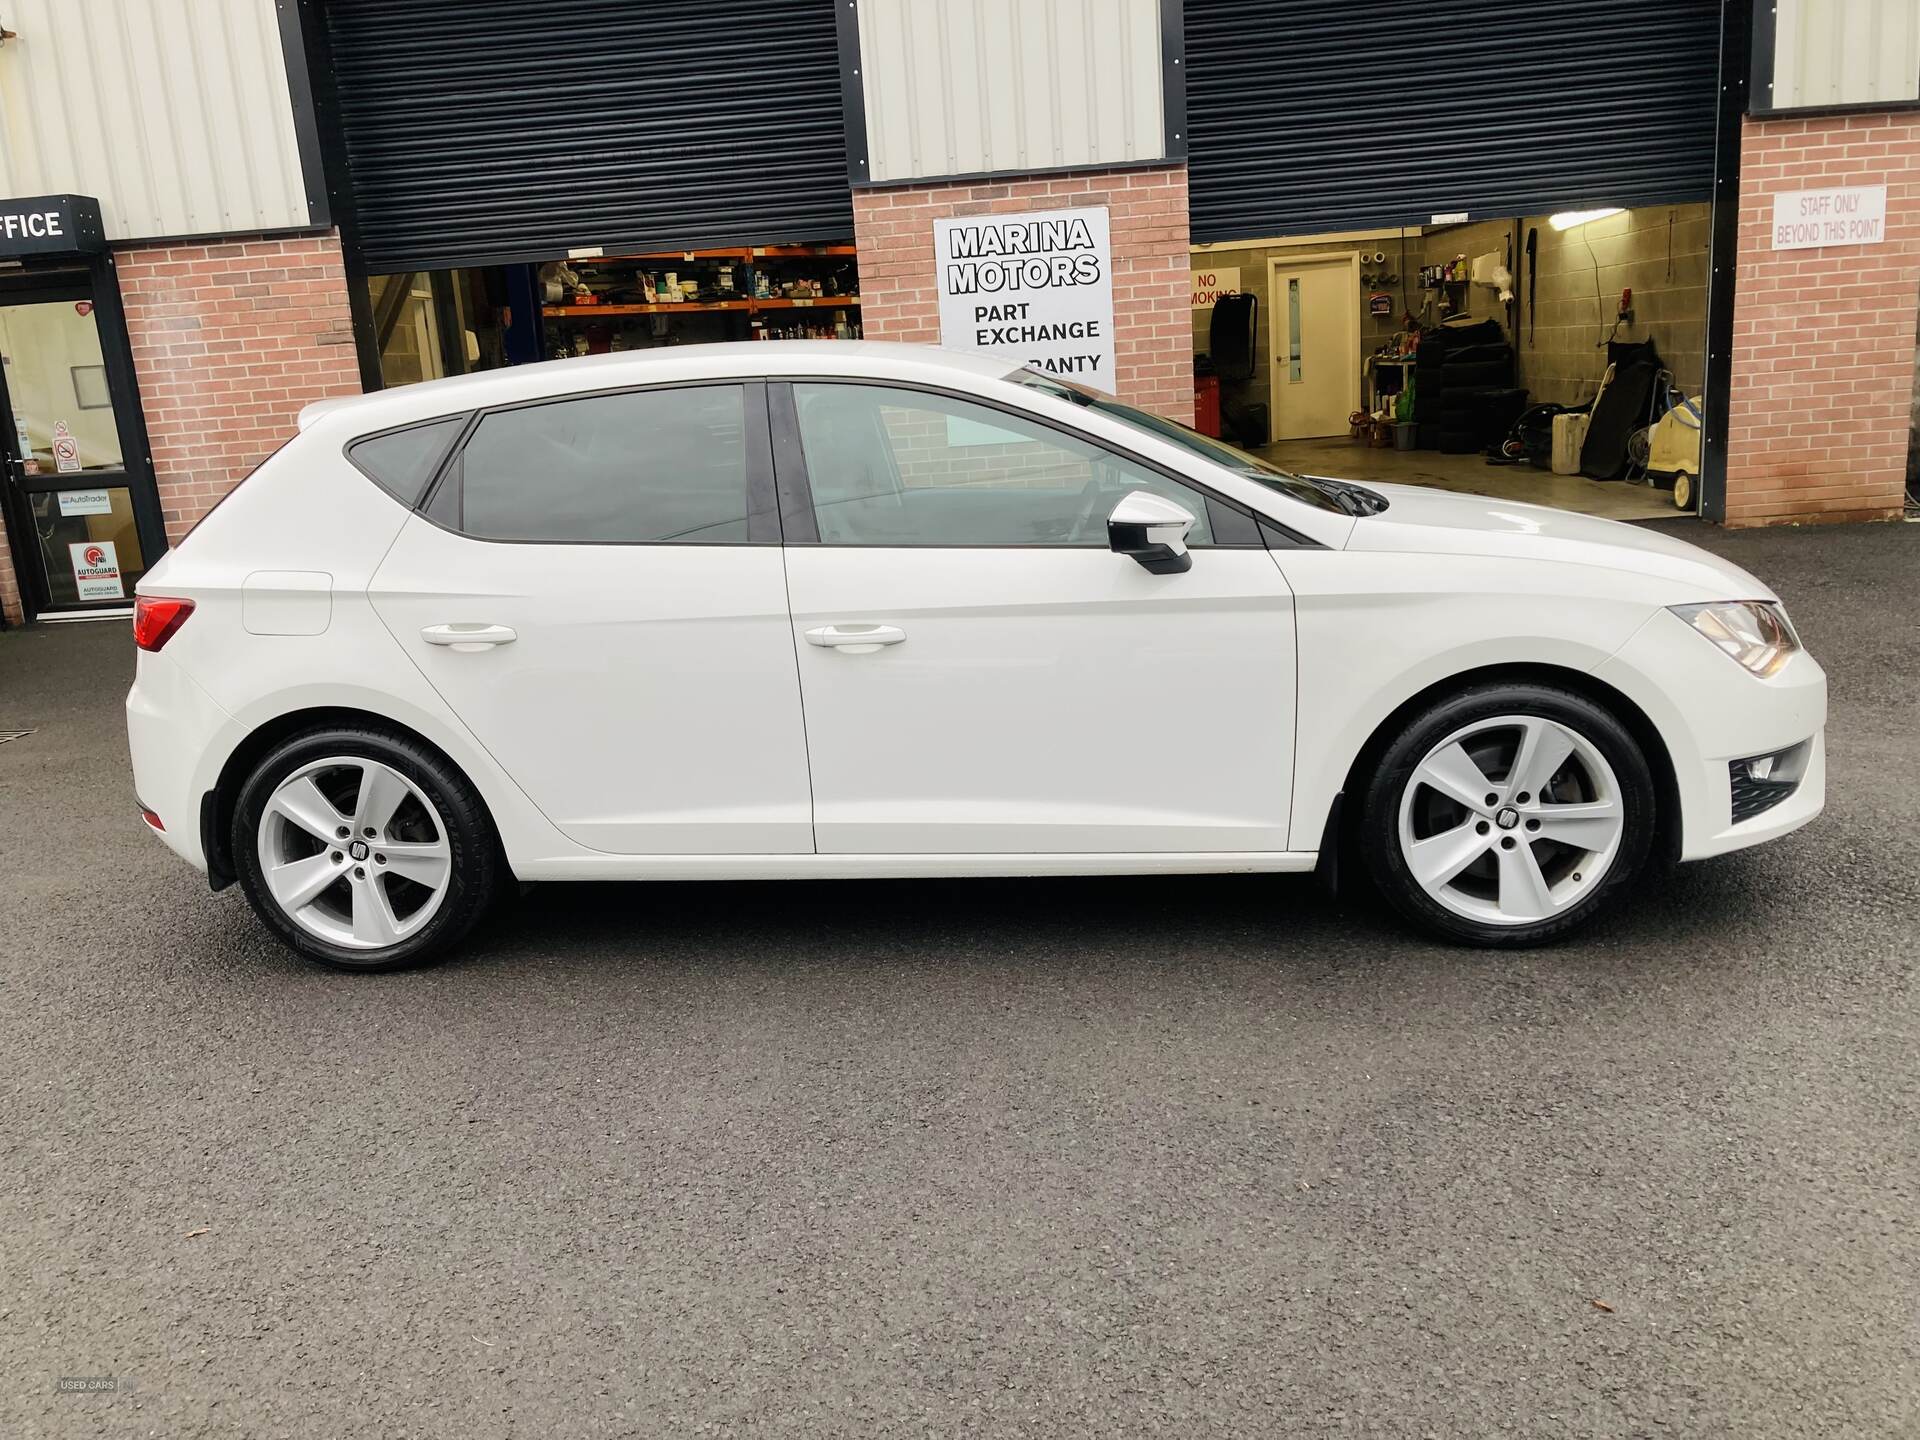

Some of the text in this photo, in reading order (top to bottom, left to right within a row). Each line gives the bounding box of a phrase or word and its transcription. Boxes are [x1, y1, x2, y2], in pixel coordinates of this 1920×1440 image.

[1800, 194, 1860, 216] STAFF ONLY
[0, 212, 63, 239] FICE
[950, 218, 1094, 258] MARINA
[1777, 218, 1880, 244] BEYOND THIS POINT
[948, 254, 1100, 294] MOTORS
[1198, 273, 1216, 287] NO
[975, 303, 1029, 323] PART
[976, 321, 1100, 346] EXCHANGE
[78, 567, 117, 576] AUTOGUARD
